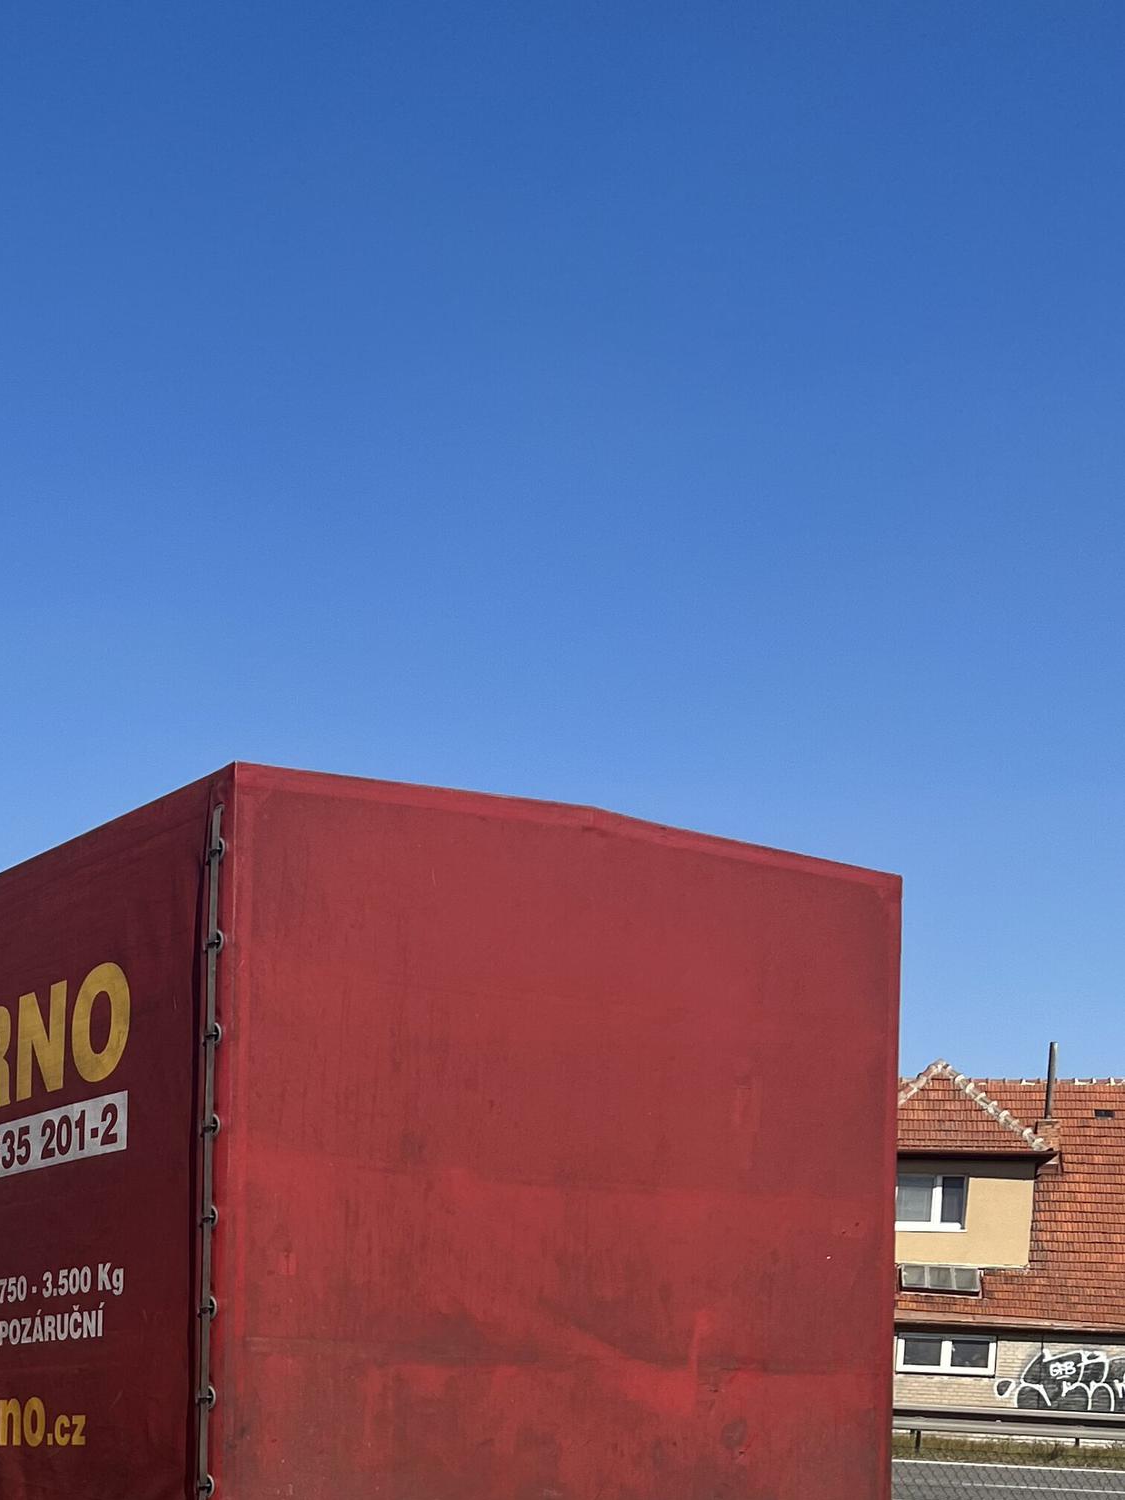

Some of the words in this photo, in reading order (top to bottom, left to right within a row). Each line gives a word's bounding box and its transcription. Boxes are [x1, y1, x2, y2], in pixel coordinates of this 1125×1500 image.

[41, 1103, 118, 1160] 201-2
[42, 1265, 91, 1298] 3.500
[97, 1262, 124, 1296] Kg
